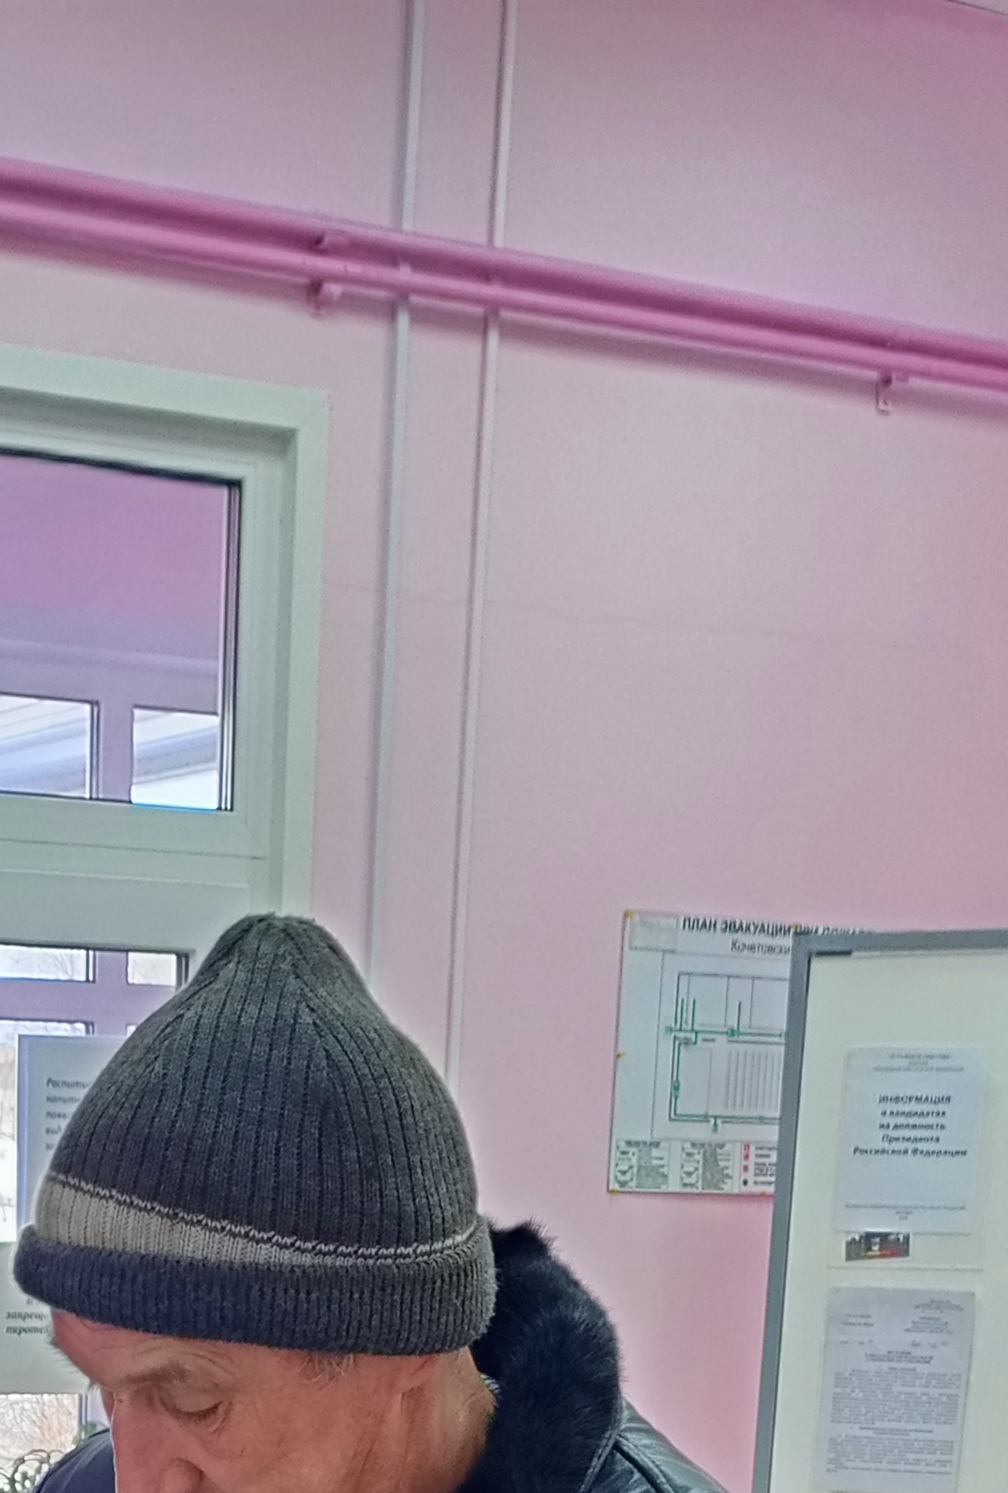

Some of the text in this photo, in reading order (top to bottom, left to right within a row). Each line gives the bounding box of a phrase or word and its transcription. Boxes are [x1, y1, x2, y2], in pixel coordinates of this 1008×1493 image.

[682, 916, 718, 933] ПЛАН
[720, 922, 792, 939] ЭВАКУАЦИИ
[878, 1093, 952, 1105] ИНФОРМАЦИЯ
[892, 1122, 946, 1131] должность
[881, 1133, 941, 1145] Президента
[853, 1146, 968, 1158] Российской Федерации
